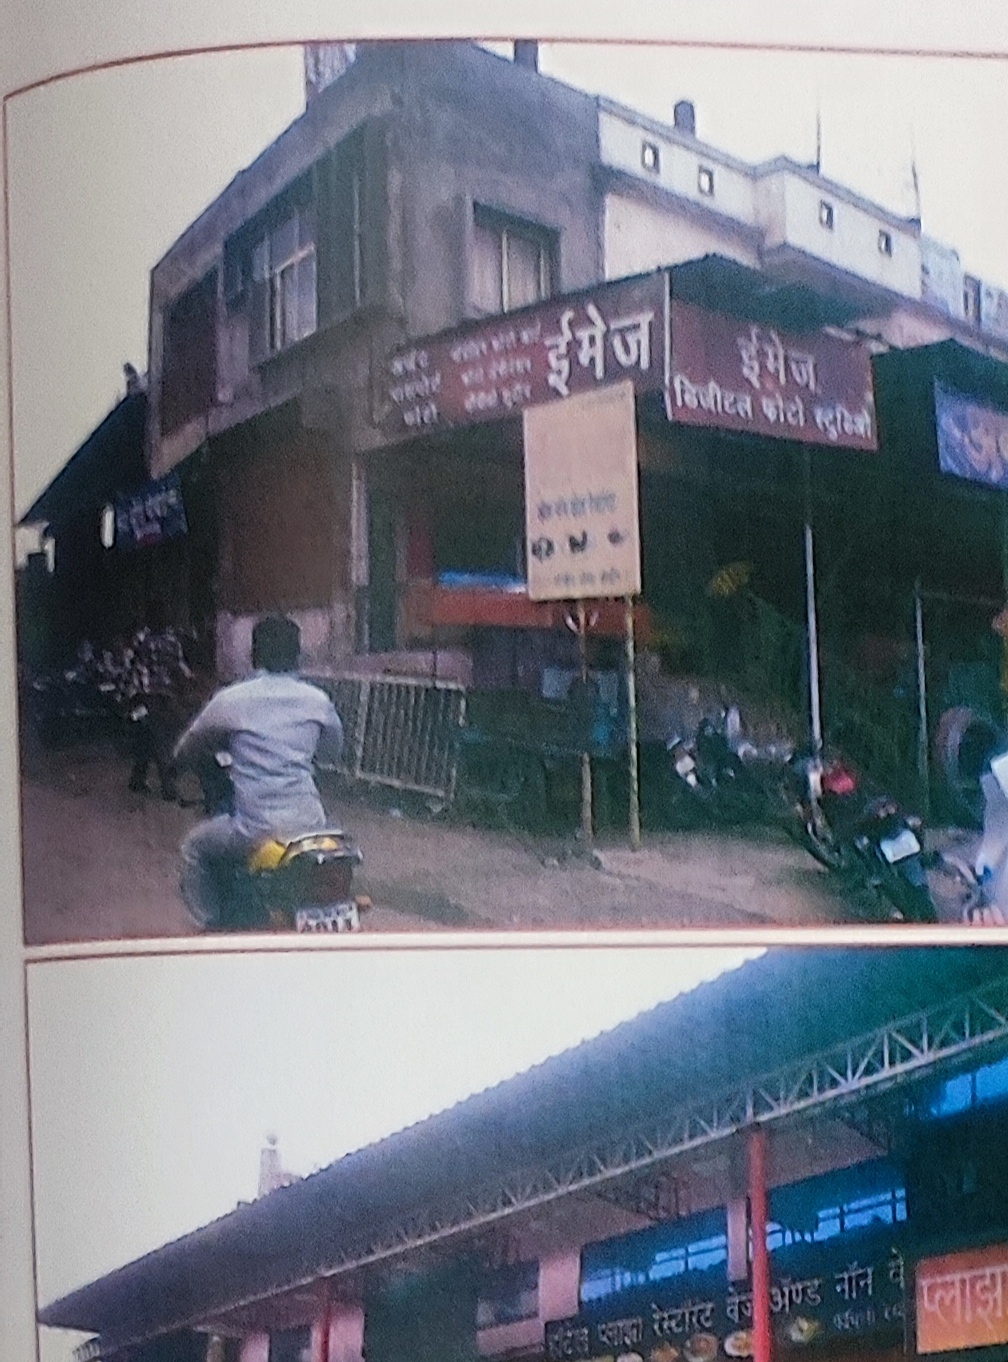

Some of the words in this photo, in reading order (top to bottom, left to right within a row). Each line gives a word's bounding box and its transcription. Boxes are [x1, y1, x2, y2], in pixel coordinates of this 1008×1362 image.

[543, 303, 655, 395] ईमेज
[737, 325, 817, 393] ईमेज
[761, 393, 805, 428] फोटो
